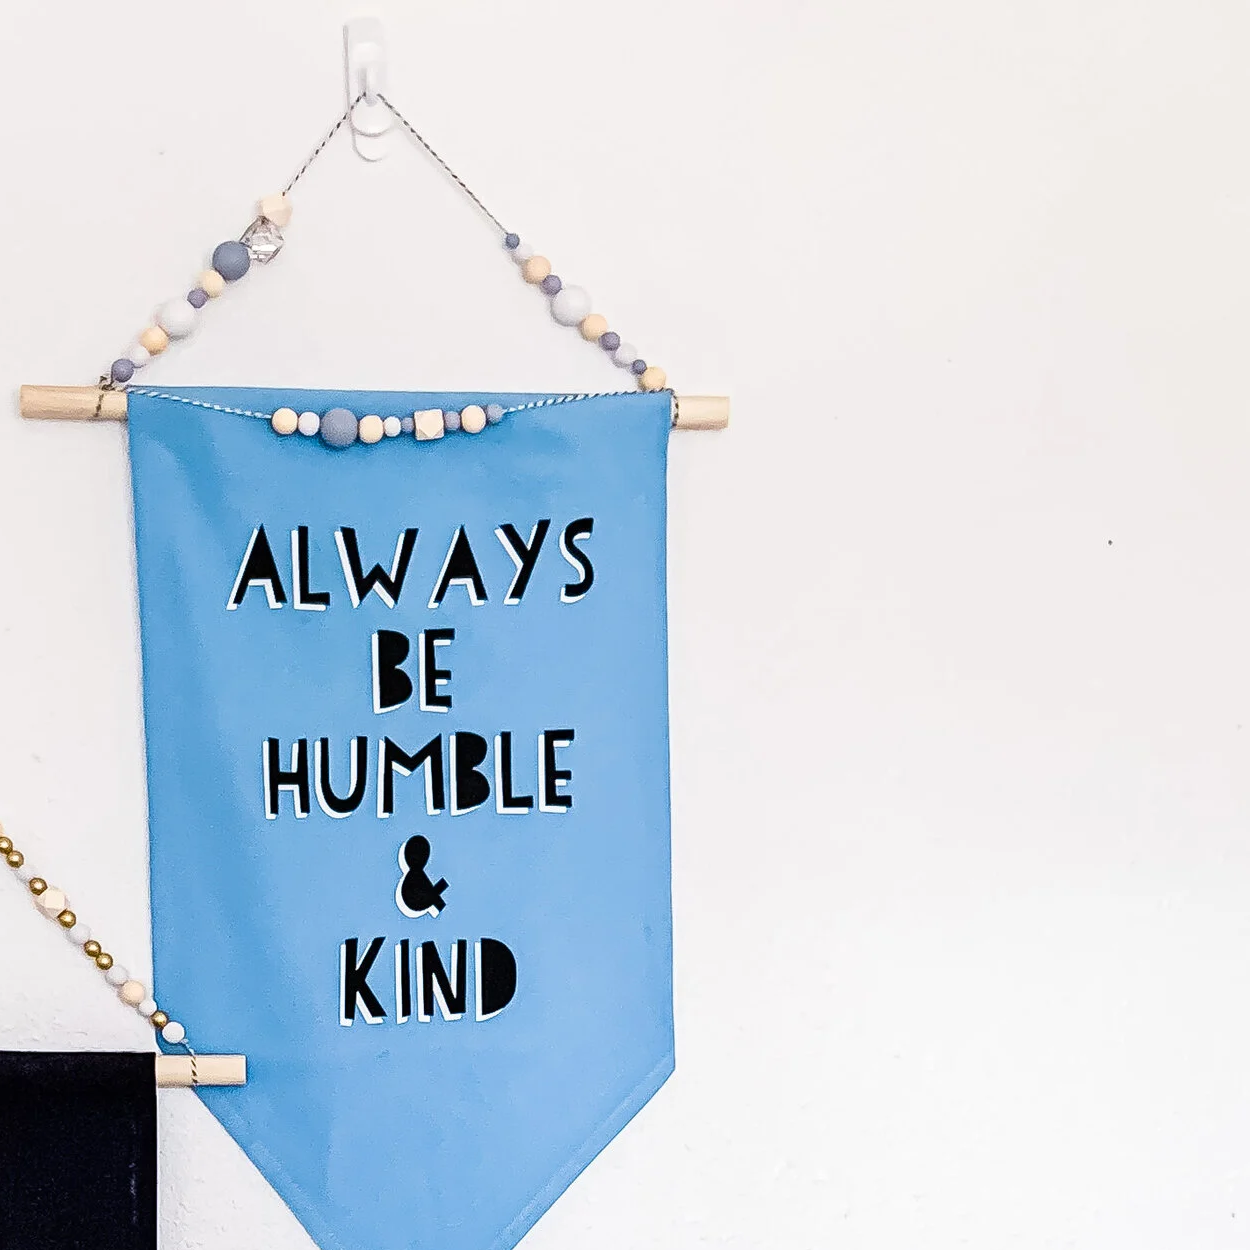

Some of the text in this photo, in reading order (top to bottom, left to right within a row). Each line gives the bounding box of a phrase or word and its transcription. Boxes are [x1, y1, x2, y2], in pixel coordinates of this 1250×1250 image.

[226, 517, 595, 611] ALWAYS
[371, 628, 456, 714] BE
[262, 728, 575, 819] HUMBLE
[395, 834, 450, 918] &
[339, 936, 518, 1026] KIND
